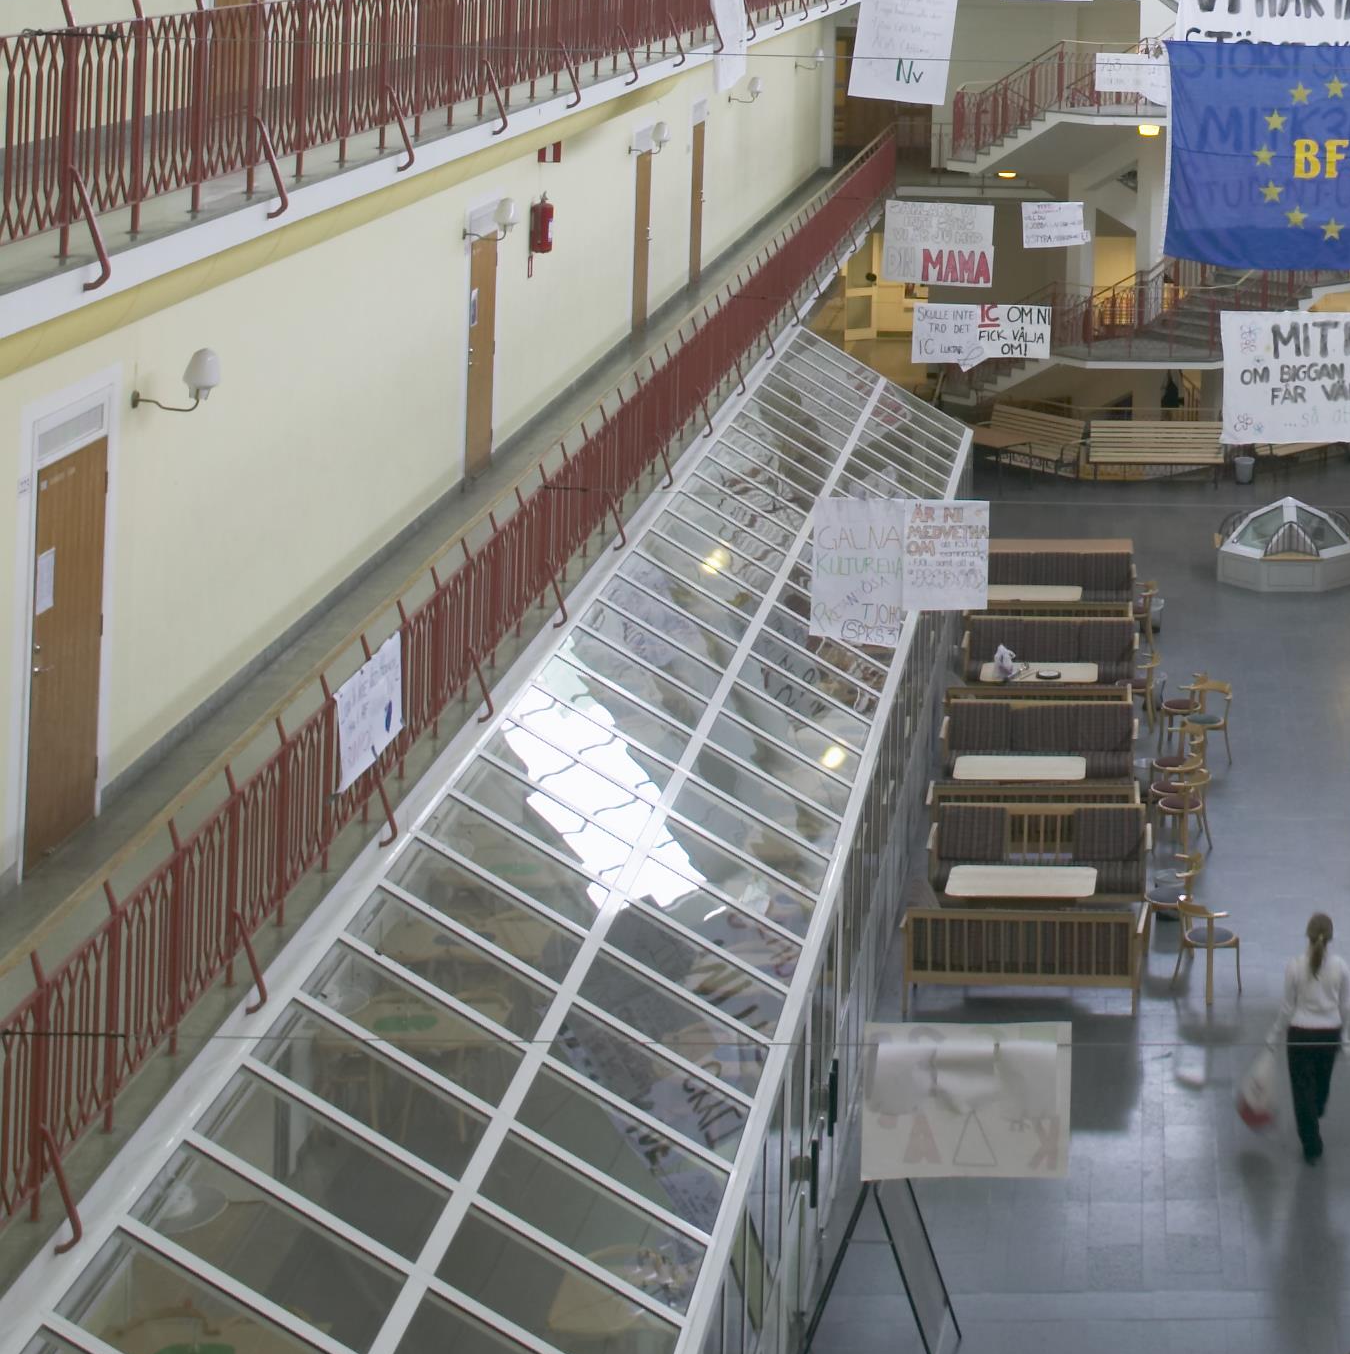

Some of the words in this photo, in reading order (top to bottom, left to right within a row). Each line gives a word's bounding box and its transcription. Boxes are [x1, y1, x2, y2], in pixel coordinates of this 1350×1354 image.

[920, 248, 991, 285] MAMA
[917, 306, 949, 321] SKULLE
[952, 309, 976, 321] INTE
[1007, 306, 1033, 325] OM
[1036, 307, 1050, 325] NI
[928, 323, 948, 333] TRO
[953, 323, 971, 333] DET
[978, 329, 1008, 342] FICK
[1000, 342, 1028, 356] OM!
[1240, 365, 1270, 386] OM
[1280, 362, 1345, 384] BIGGAN
[910, 502, 936, 523] ÄR
[943, 506, 964, 523] NI
[817, 524, 903, 551] GALNA
[905, 540, 936, 557] OM
